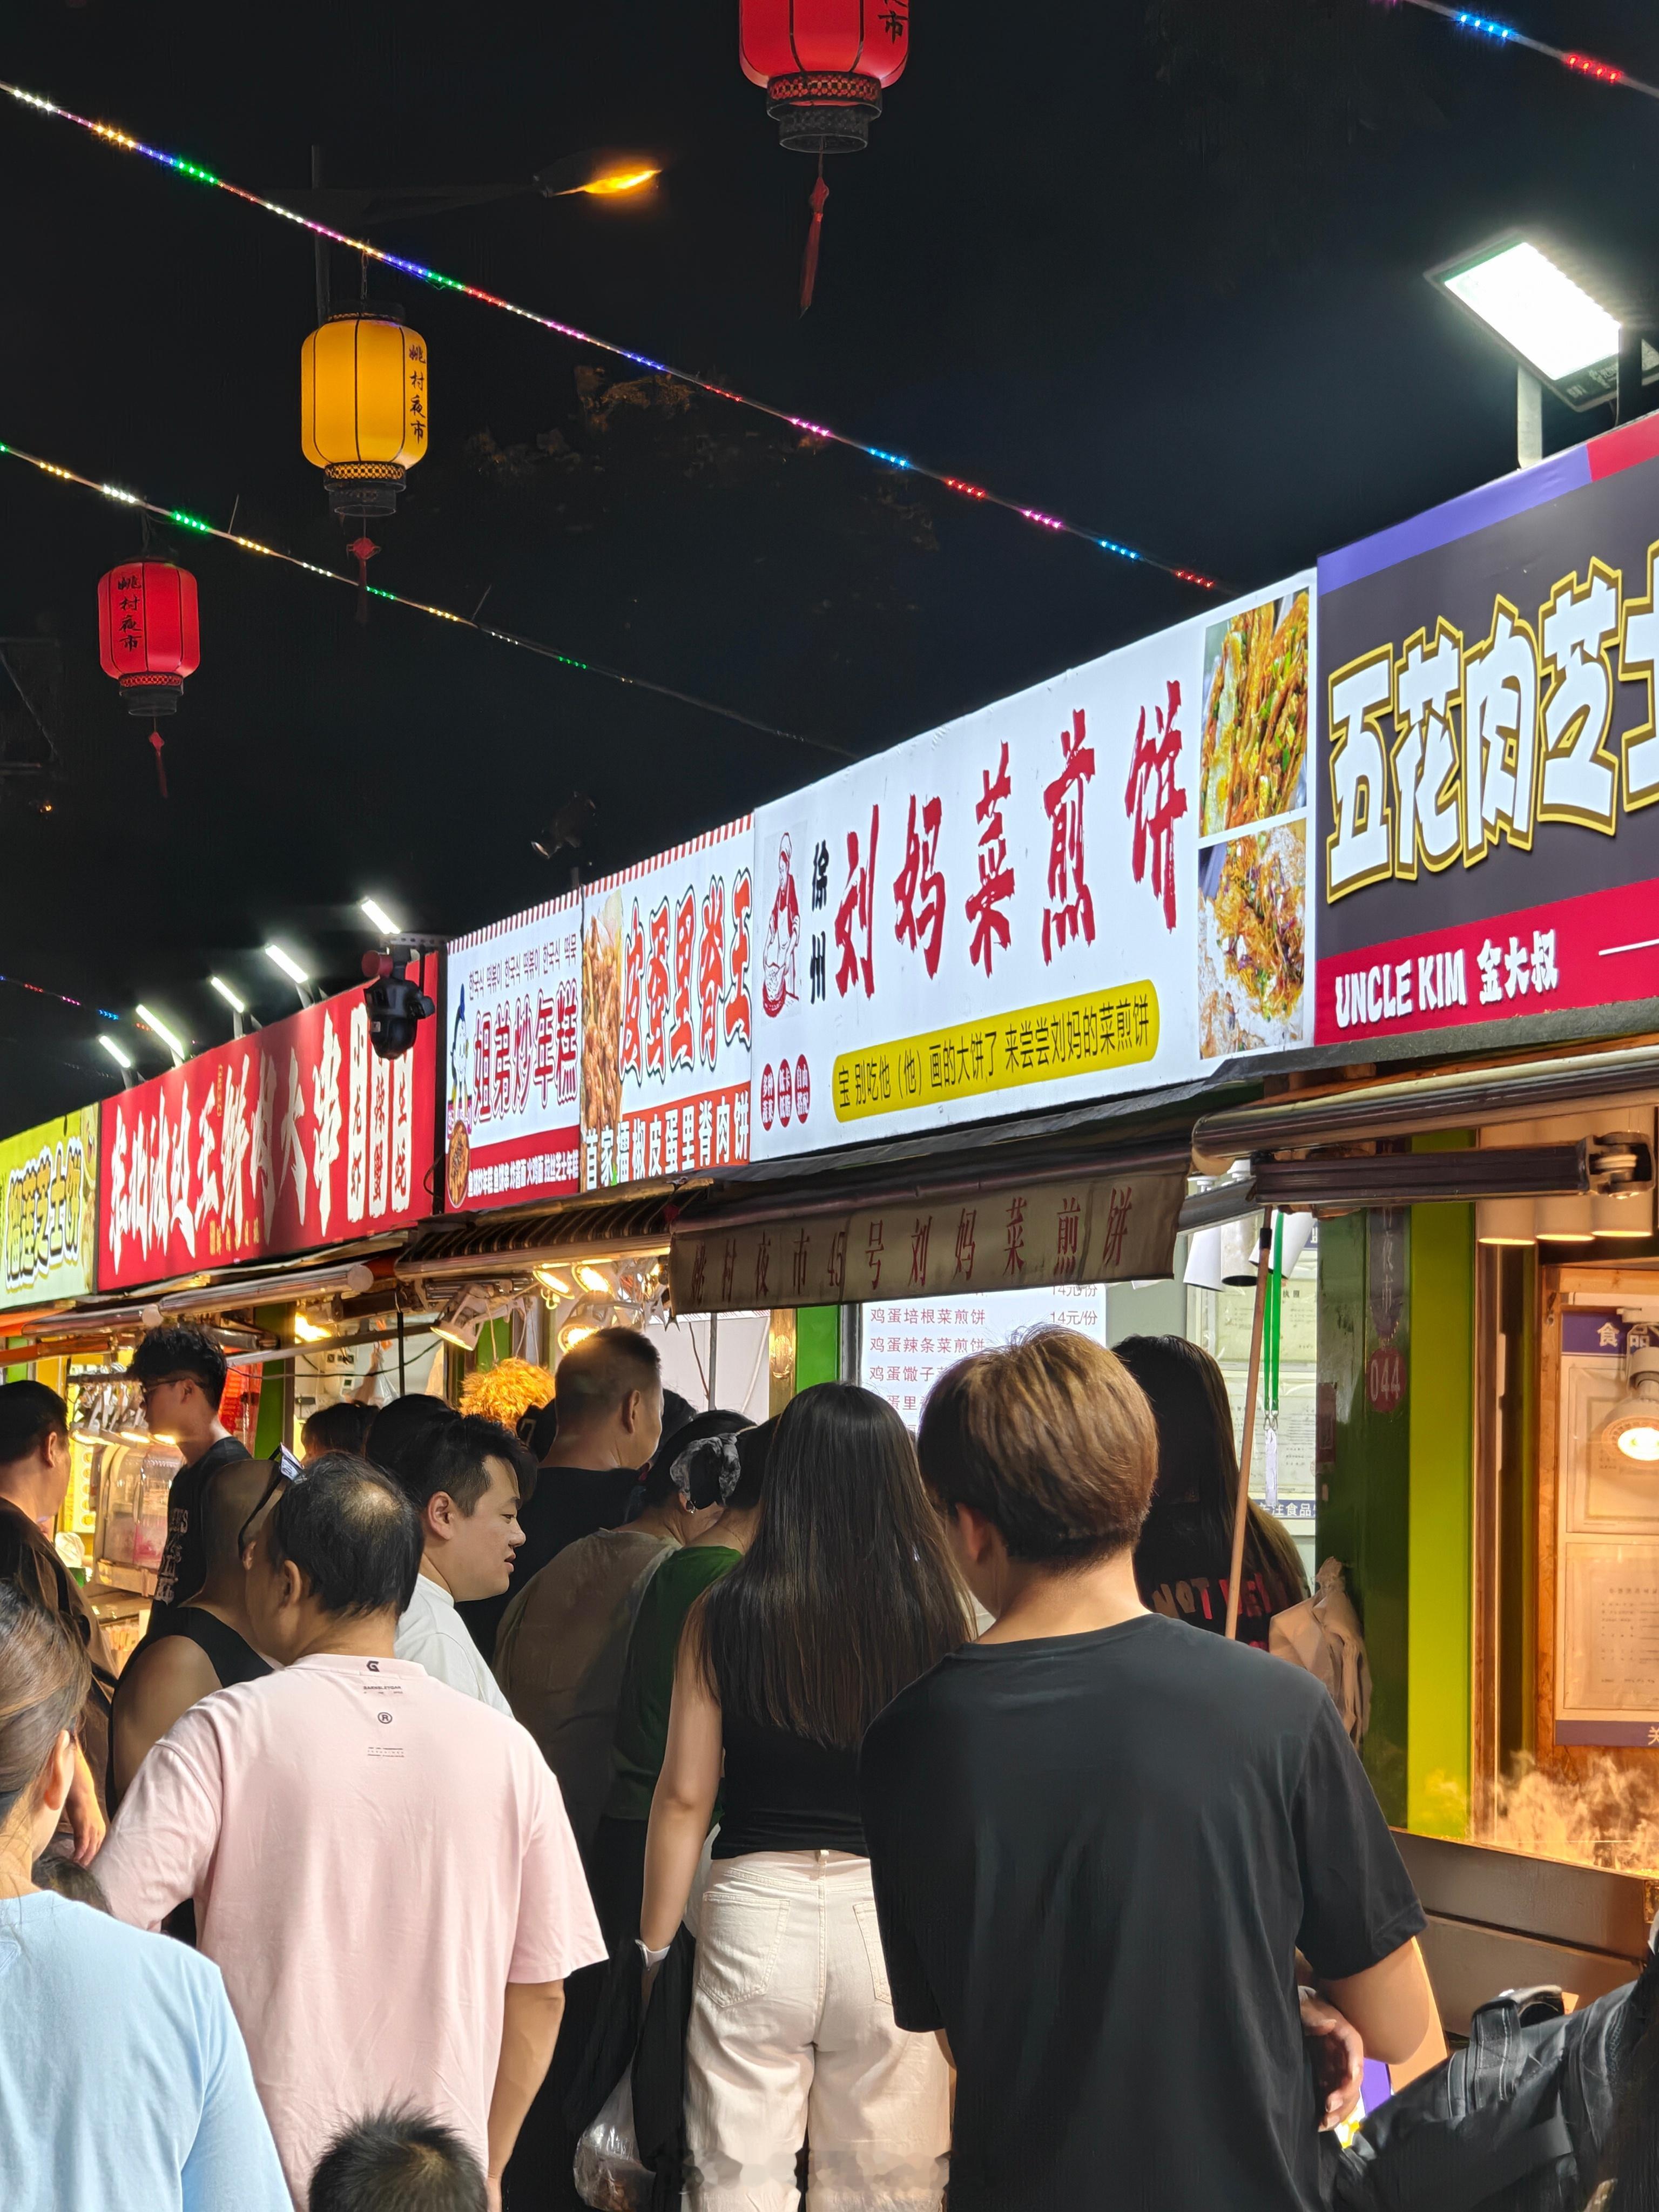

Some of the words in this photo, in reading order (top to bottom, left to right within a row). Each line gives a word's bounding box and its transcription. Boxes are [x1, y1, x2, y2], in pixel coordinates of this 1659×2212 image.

[878, 0, 909, 44] 市
[835, 680, 1188, 999] 刘妈菜煎饼
[469, 967, 484, 1001] 한국식
[505, 953, 521, 988] 한국식
[543, 938, 561, 974] 한국식
[810, 841, 828, 1004] 徐州
[619, 867, 751, 1087] 皮蛋里脊王
[1336, 959, 1413, 1028] UNCLE
[1418, 948, 1467, 1010] KIM
[1477, 929, 1559, 1004] 金大叔
[473, 979, 578, 1122] 姐弟炒年糕
[797, 1064, 808, 1089] 自由
[839, 1064, 851, 1108] 宝
[1005, 993, 1149, 1073] 来尝尝刘妈的菜煎饼
[6, 1141, 83, 1286] 榴莲芝士饼
[870, 1337, 985, 1354] 鸡蛋辣条菜煎饼
[871, 1308, 985, 1325] 鸡蛋培根菜煎饼
[1050, 1310, 1098, 1326] 14元/份
[1370, 1356, 1401, 1402] 044
